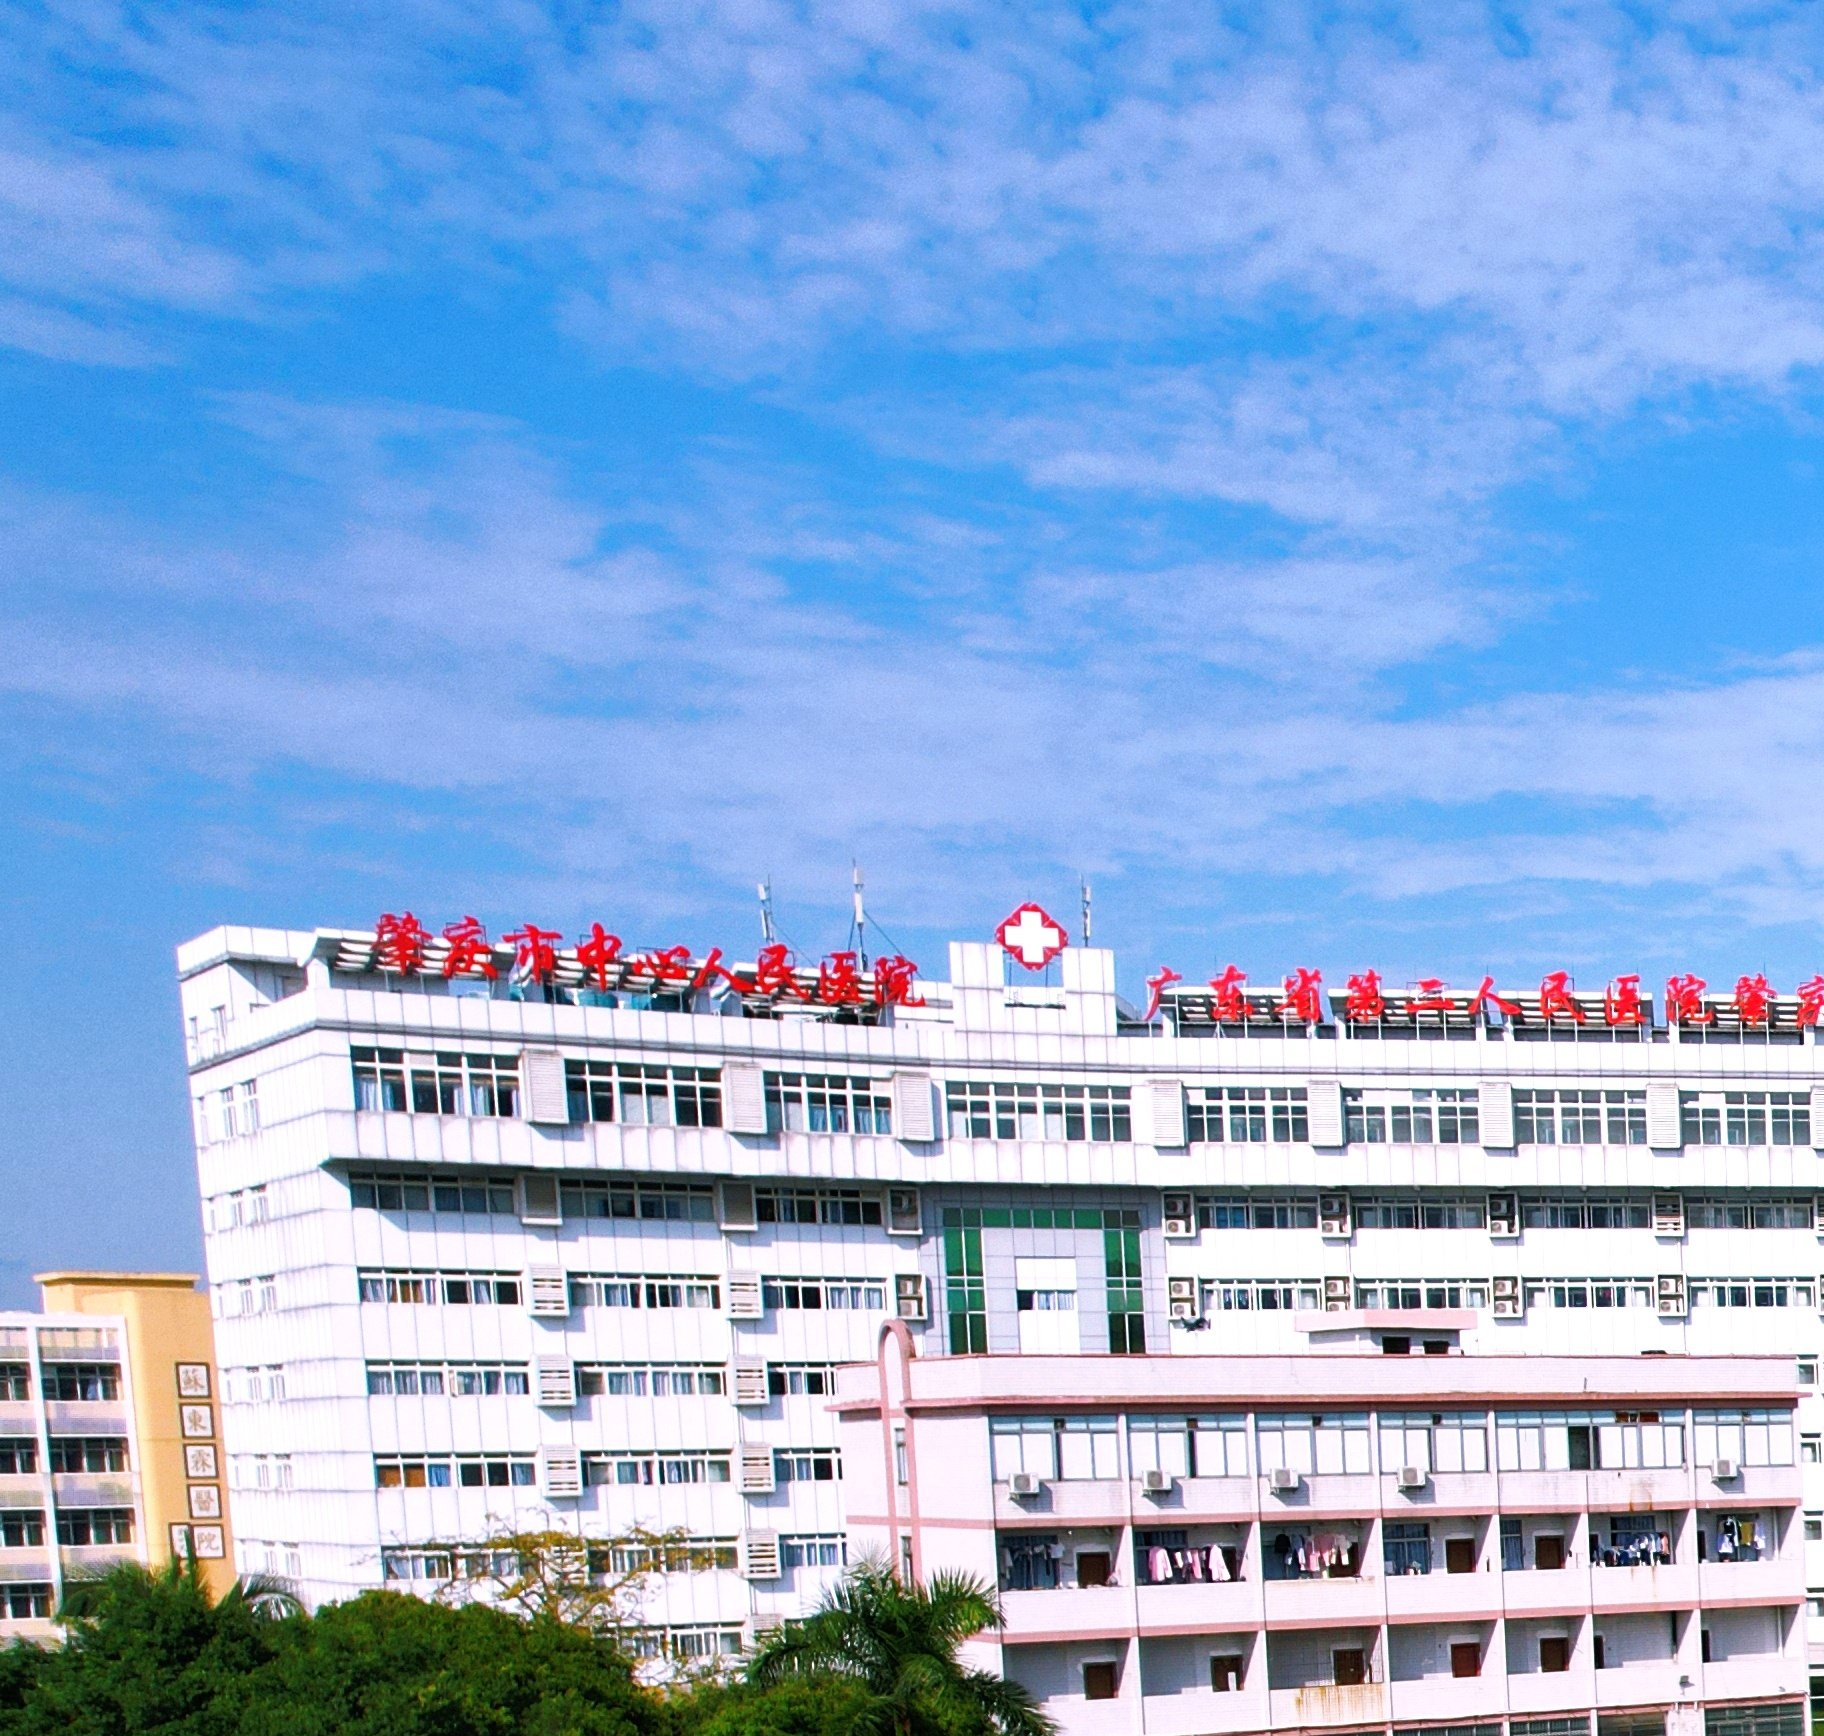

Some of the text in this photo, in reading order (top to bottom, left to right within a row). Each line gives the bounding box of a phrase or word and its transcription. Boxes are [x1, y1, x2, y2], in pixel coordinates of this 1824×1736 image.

[373, 913, 926, 1008] 肇庆市中心人民医院
